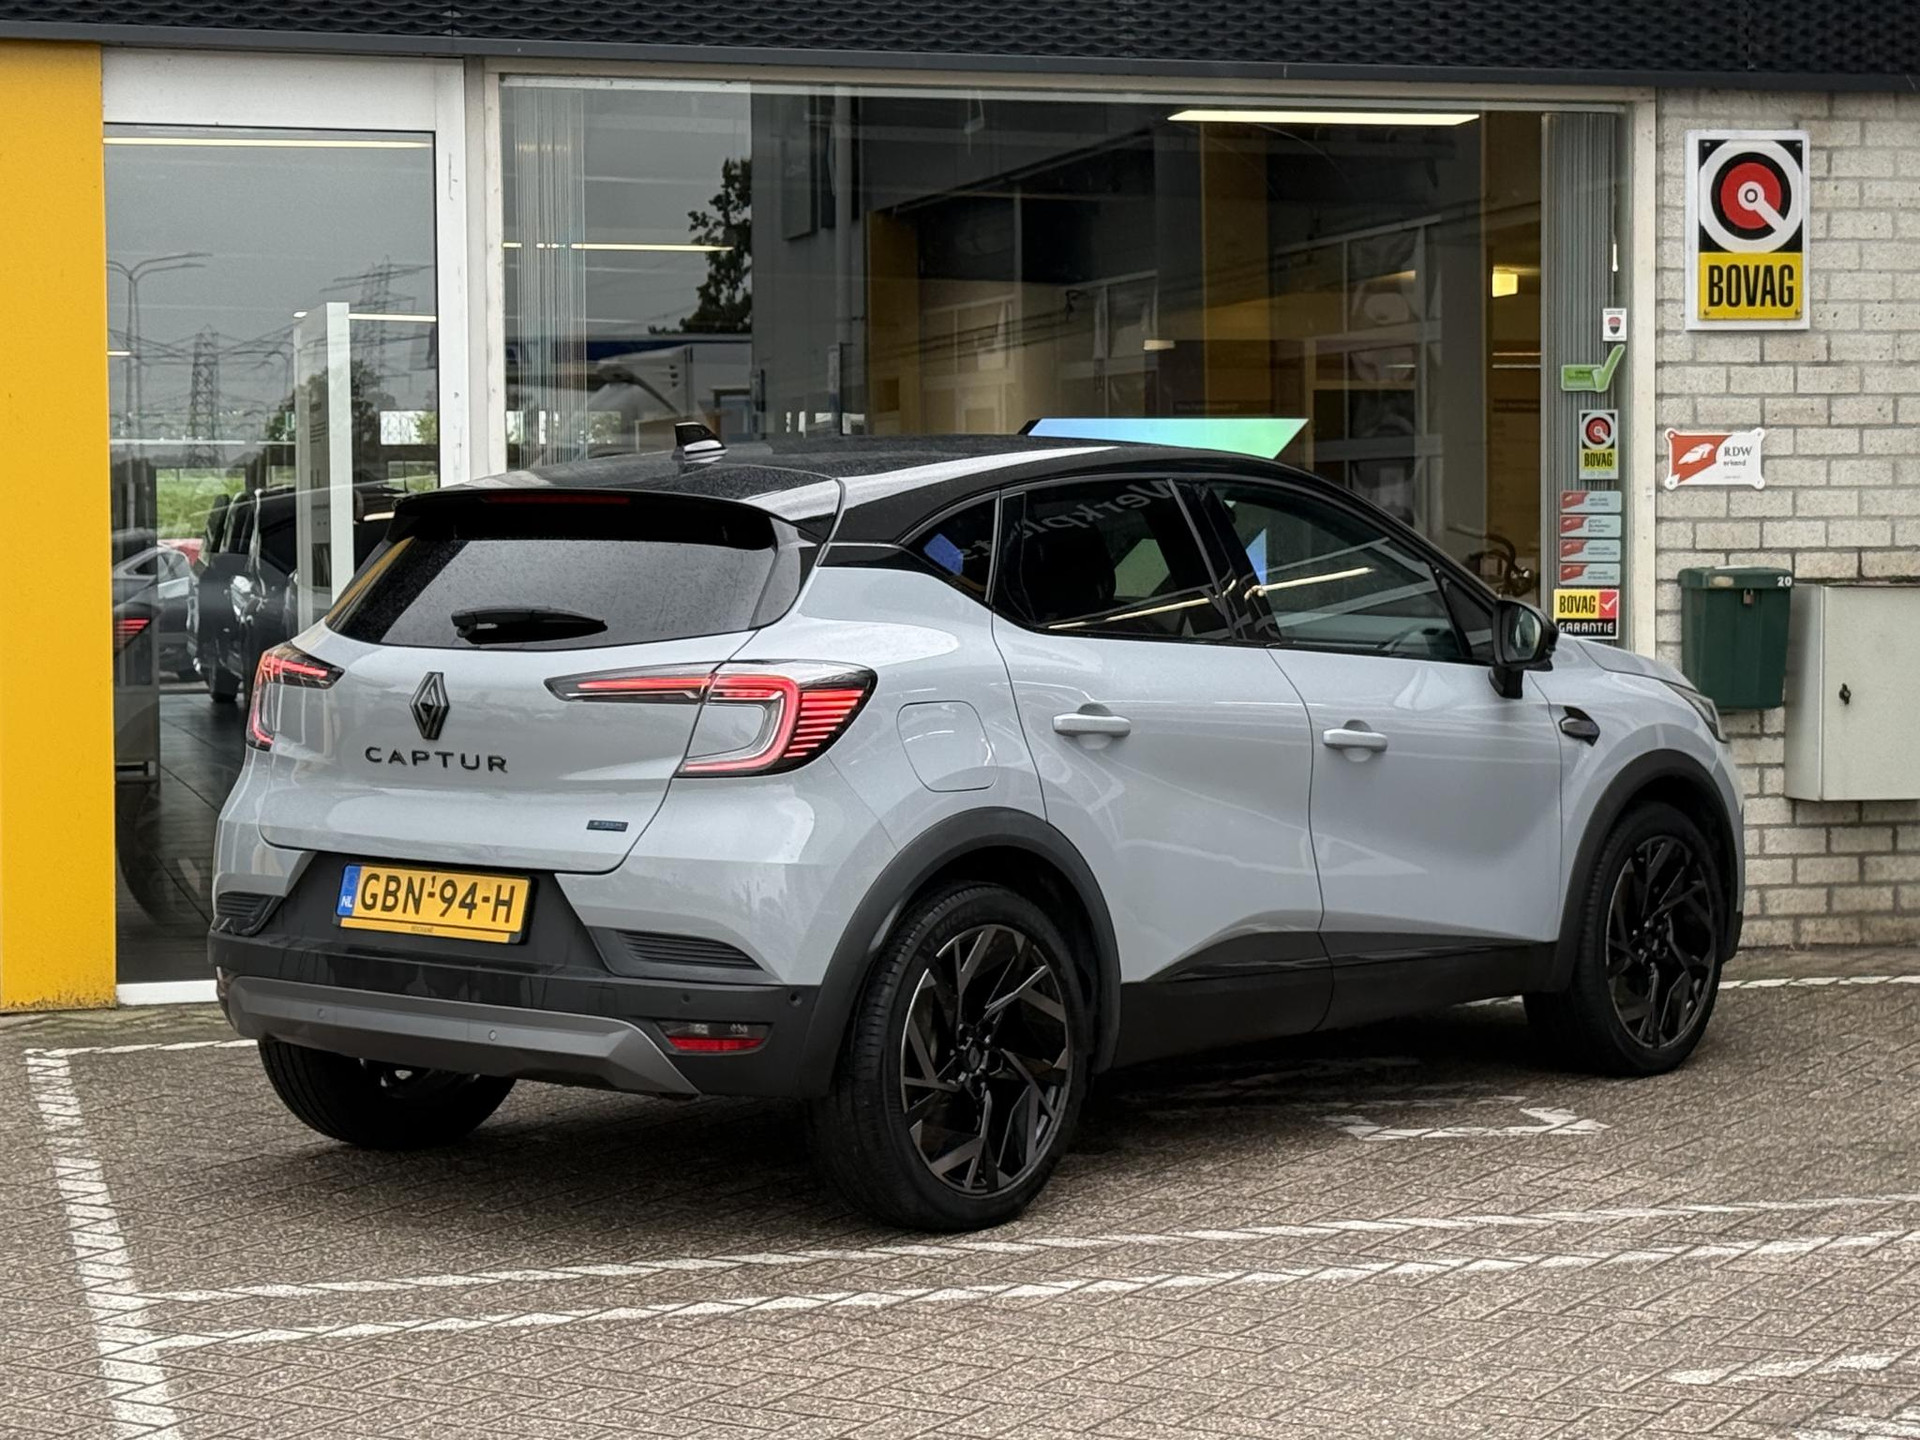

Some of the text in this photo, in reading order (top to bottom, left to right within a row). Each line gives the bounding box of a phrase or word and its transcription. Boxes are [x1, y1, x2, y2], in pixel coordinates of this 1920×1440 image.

[1708, 264, 1794, 308] BOVAG
[1584, 452, 1613, 467] BOVAG
[1724, 446, 1753, 457] RDW
[1776, 576, 1793, 587] 20
[1559, 595, 1596, 614] BOVAG
[1558, 622, 1614, 633] GARANTIE
[365, 746, 509, 774] CAPTUR
[341, 873, 516, 924] NL GBN-94-H
